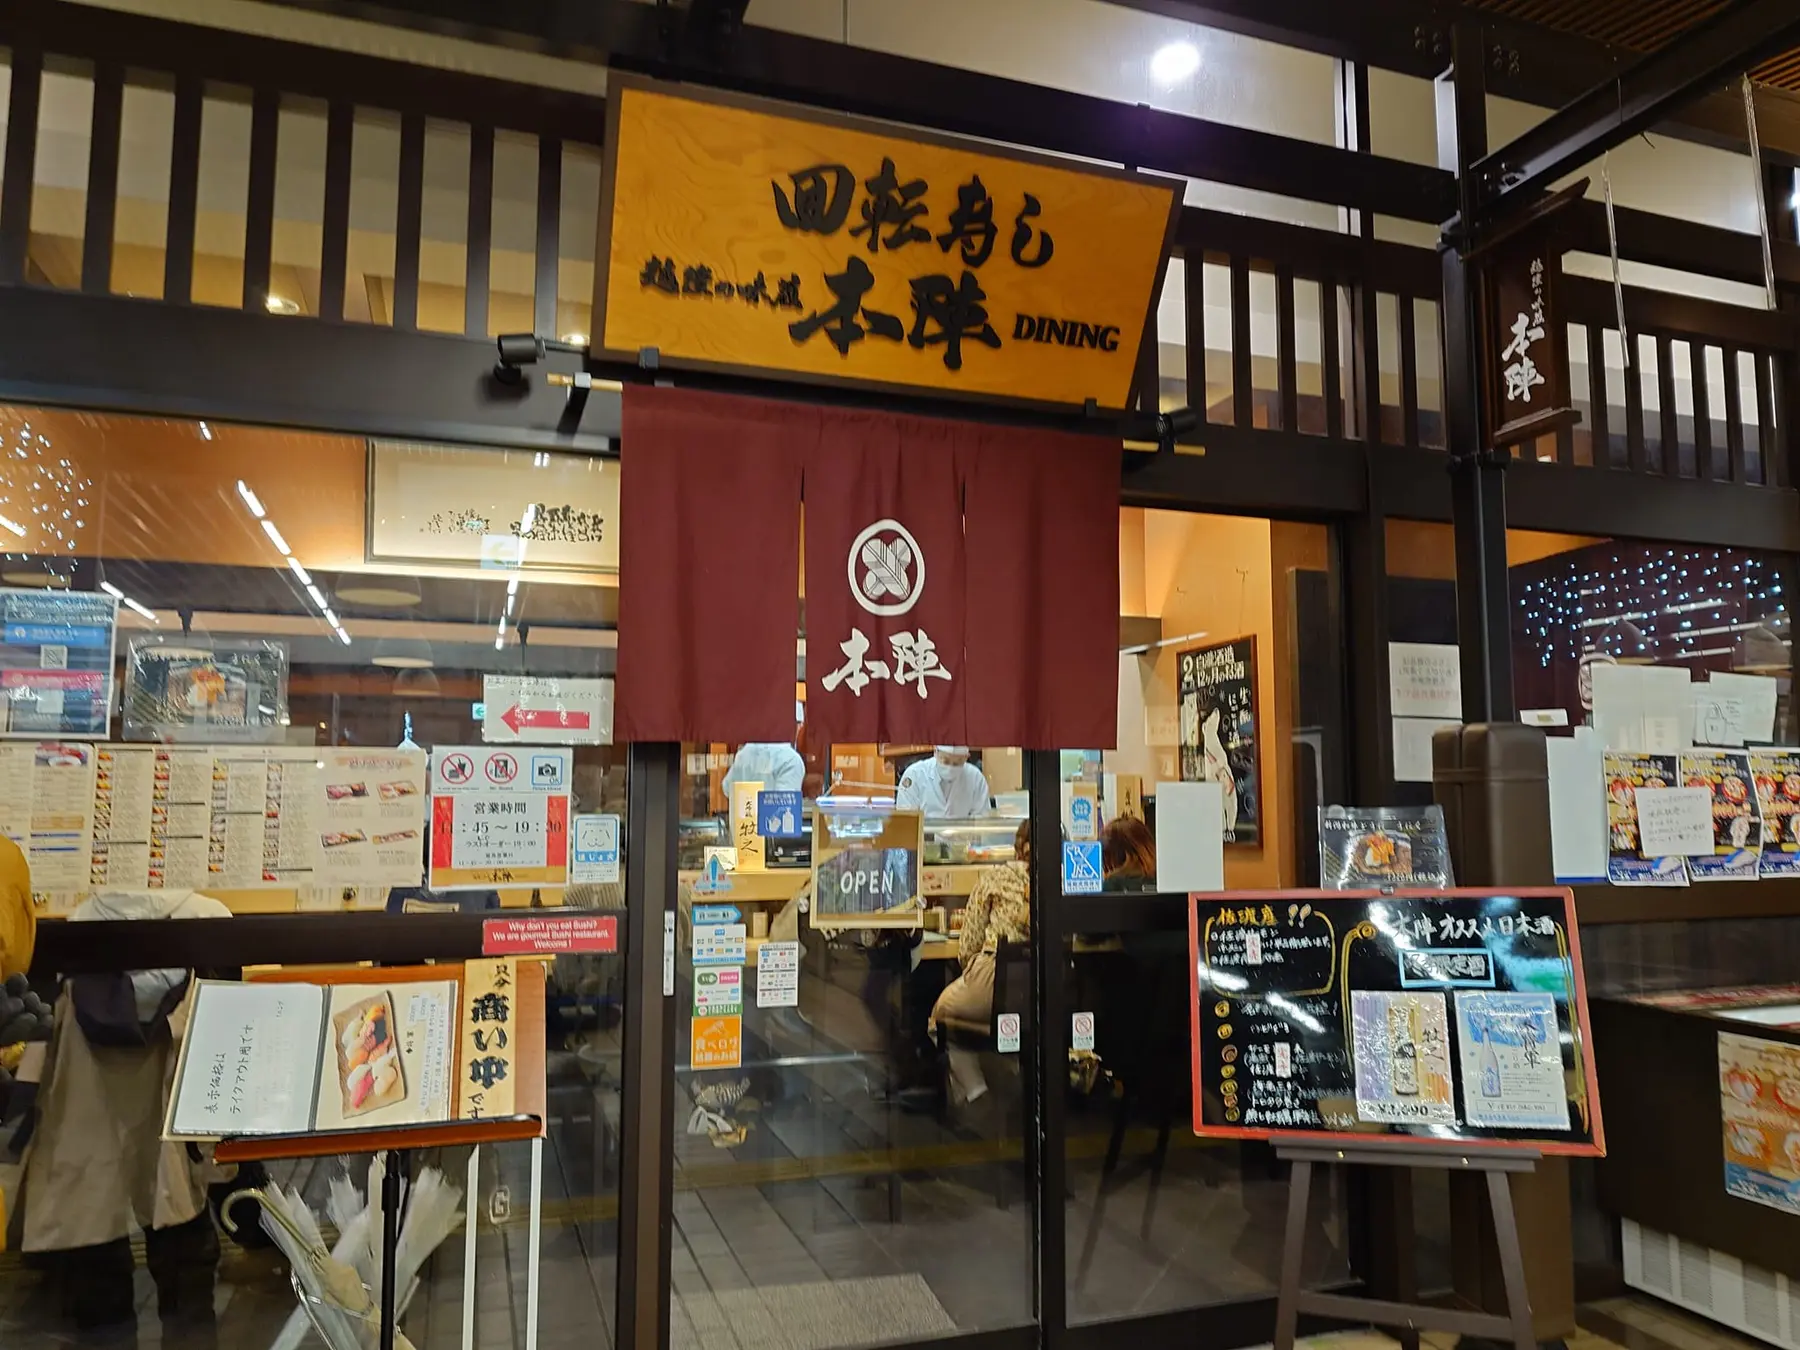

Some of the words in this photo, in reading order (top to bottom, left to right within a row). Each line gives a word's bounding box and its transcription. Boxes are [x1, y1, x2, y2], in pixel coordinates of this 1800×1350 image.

[772, 157, 1054, 268] 回転寿し
[789, 257, 1002, 370] 本陣
[1013, 314, 1120, 352] DINING
[1502, 312, 1546, 402] 本陣
[822, 628, 952, 700] 本陣
[473, 801, 527, 815] 営業時間
[840, 869, 894, 895] OPEN
[492, 931, 506, 941] We
[507, 931, 520, 941] are
[520, 930, 550, 943] gourmet
[508, 921, 526, 932] Why
[527, 921, 545, 931] don't
[546, 921, 560, 932] you
[561, 920, 572, 930] eat
